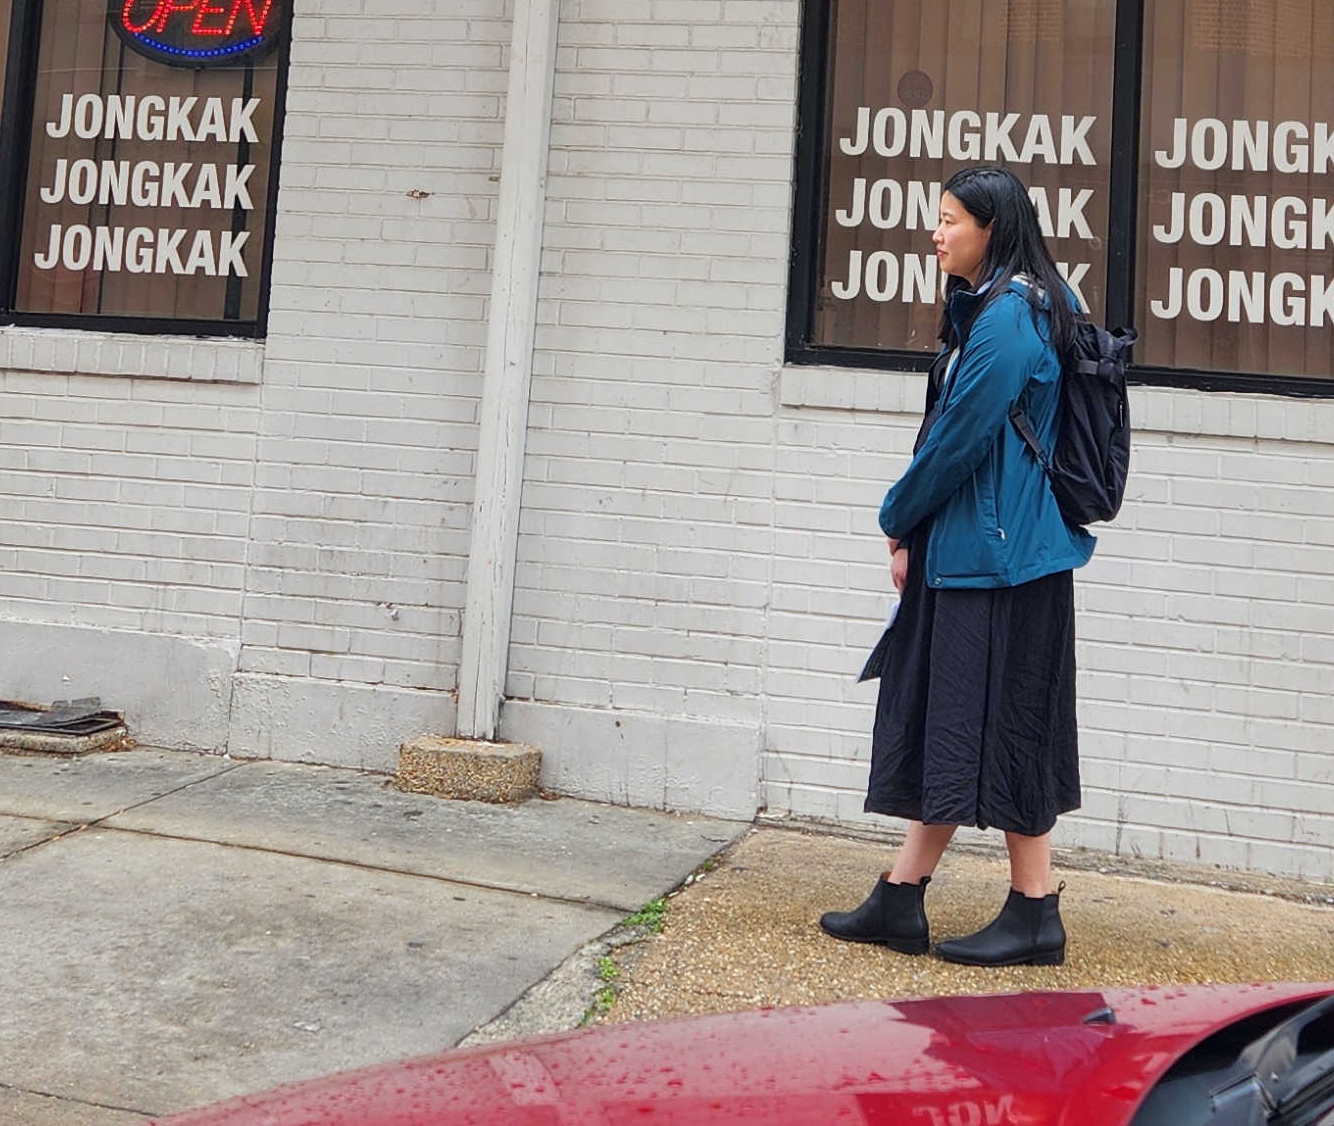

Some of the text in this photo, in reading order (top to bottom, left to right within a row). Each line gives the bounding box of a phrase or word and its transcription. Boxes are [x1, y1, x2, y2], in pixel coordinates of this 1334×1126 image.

[46, 93, 262, 144] JONGKAK
[839, 106, 1098, 166] JONGKAK
[40, 158, 257, 211] JONGKAK
[835, 177, 1095, 240] JONAK
[34, 223, 251, 278] JONGKAK
